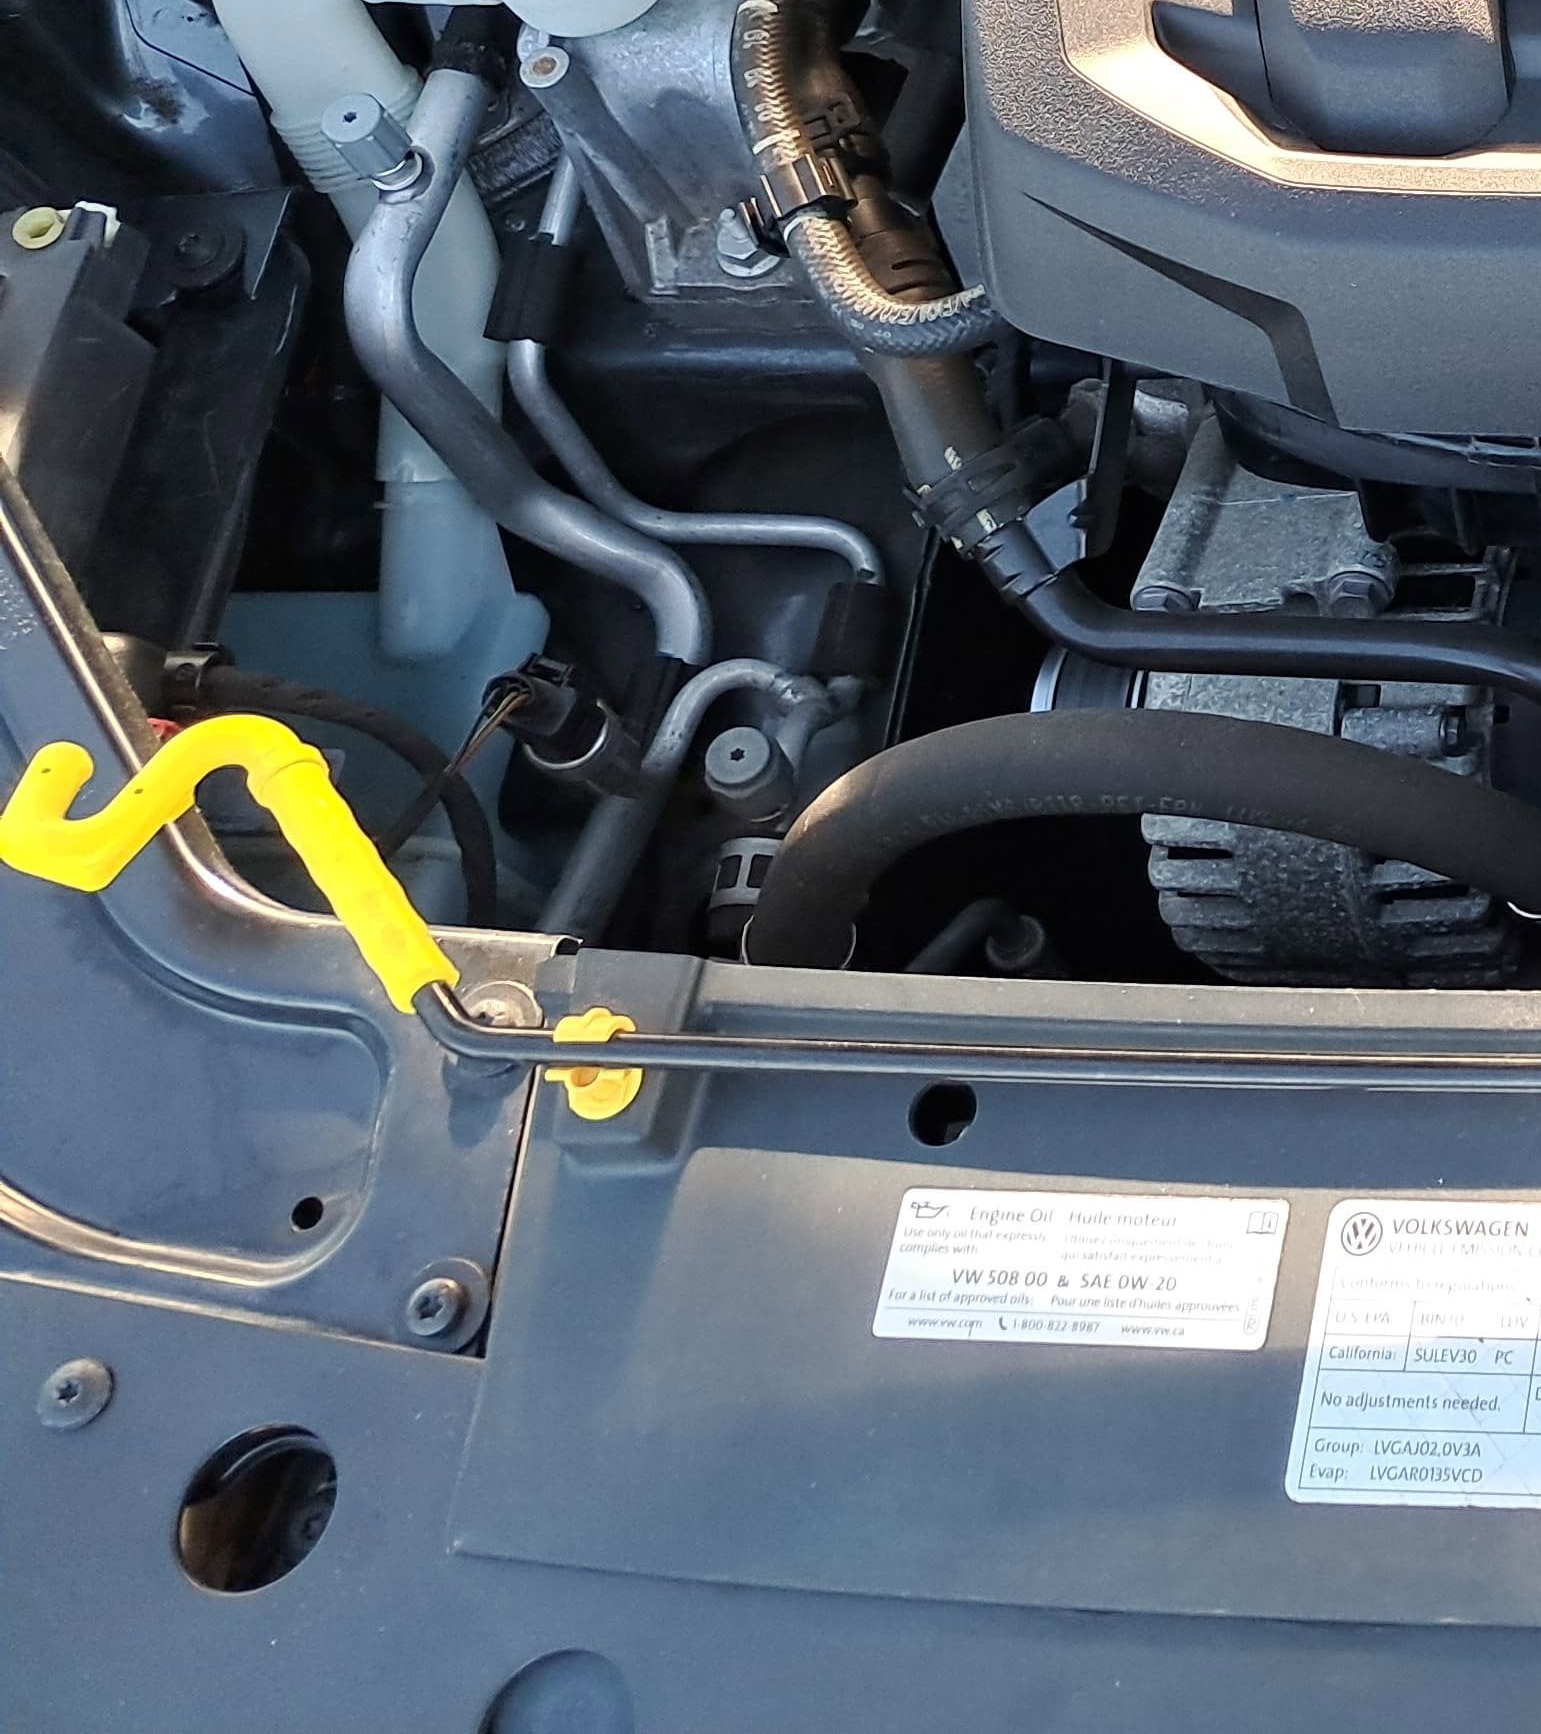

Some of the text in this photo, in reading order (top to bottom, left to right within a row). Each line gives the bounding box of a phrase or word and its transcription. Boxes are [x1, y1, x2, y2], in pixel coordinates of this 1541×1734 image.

[970, 1206, 1053, 1226] Engine Oil
[1069, 1210, 1111, 1226] Huile
[1392, 1218, 1529, 1237] VOLKSWAGEN
[952, 1268, 984, 1284] VW
[988, 1269, 1019, 1286] 508
[1024, 1271, 1048, 1287] 00
[1080, 1273, 1111, 1289] SAE
[919, 1289, 935, 1298] list
[938, 1290, 953, 1301] of
[953, 1292, 1009, 1306] approved
[1079, 1298, 1101, 1307] une
[1328, 1344, 1397, 1362] California:
[1414, 1349, 1477, 1364] SULEV30
[1494, 1350, 1514, 1365] PC
[1321, 1392, 1501, 1412] No adjustments needed.
[1314, 1438, 1363, 1458] Group:
[1309, 1463, 1483, 1484] Evap: LVGAR0135VCD
